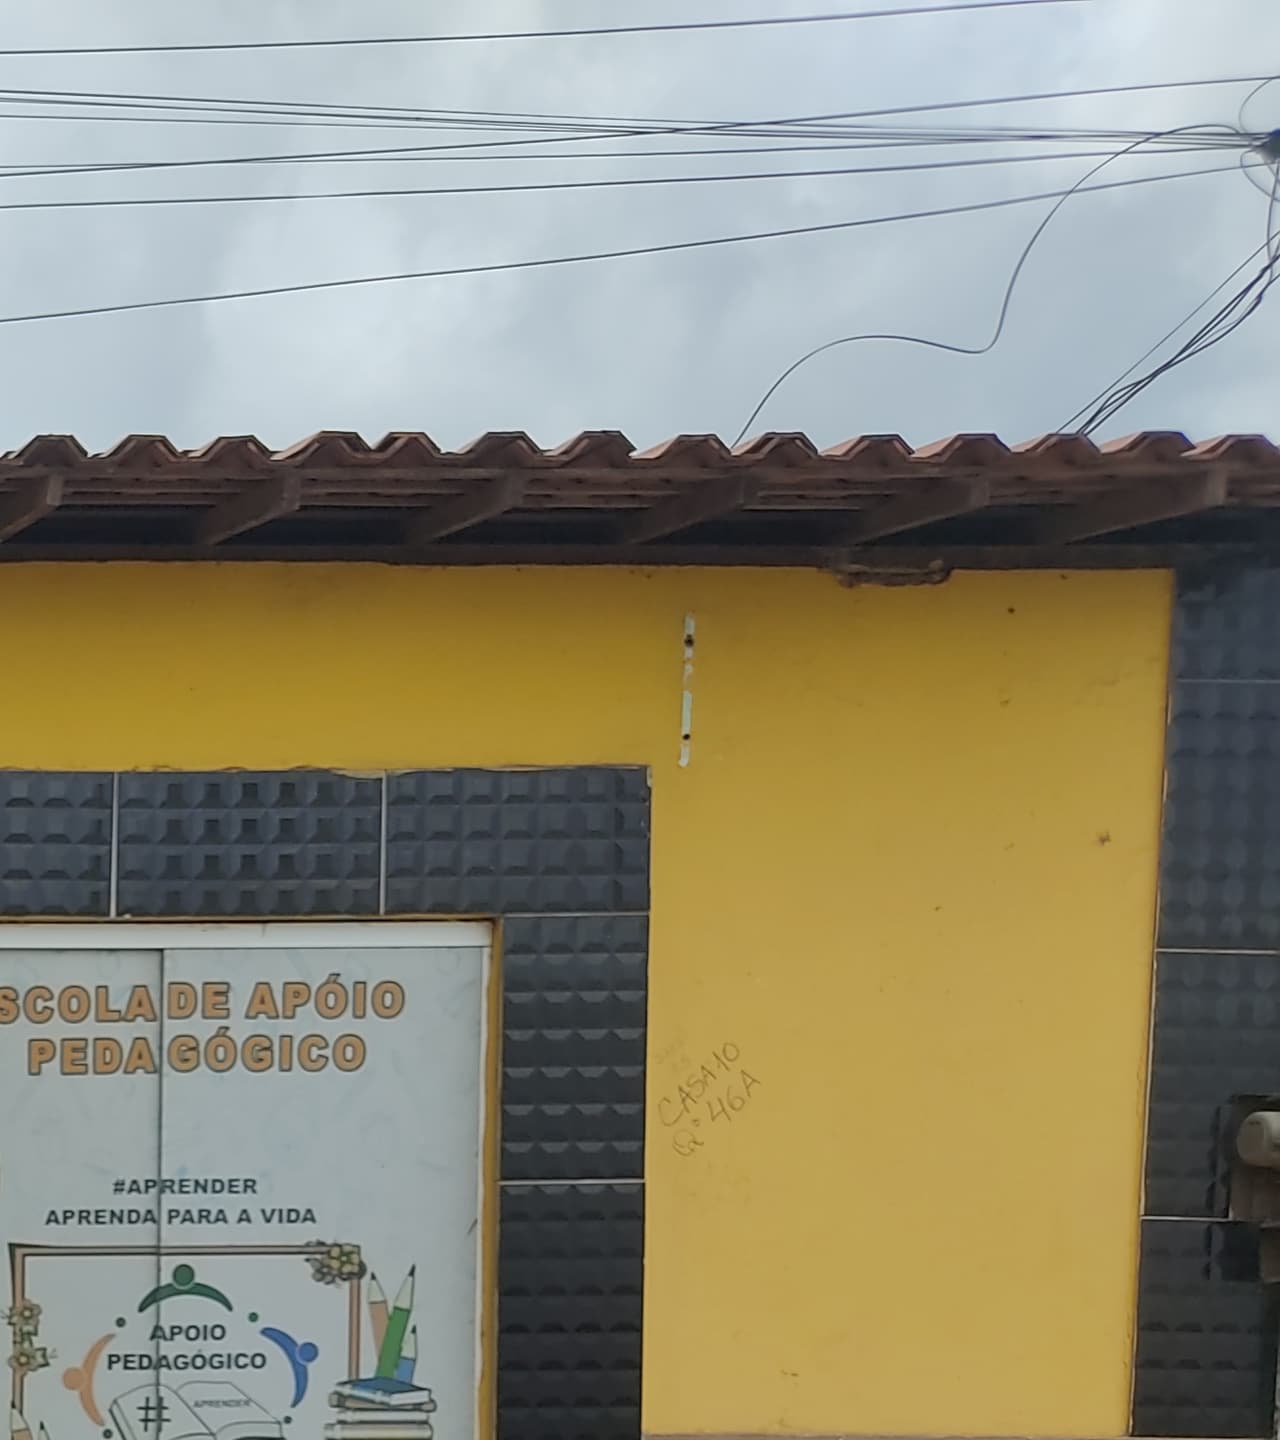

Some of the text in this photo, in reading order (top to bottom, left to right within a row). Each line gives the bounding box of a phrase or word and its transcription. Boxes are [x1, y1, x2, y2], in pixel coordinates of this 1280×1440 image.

[167, 981, 231, 1020] DE
[244, 973, 406, 1020] APÓIO
[28, 1026, 367, 1076] PEDAGÓGICO
[658, 1064, 718, 1127] CASA
[112, 1178, 258, 1195] #APRENDER
[44, 1208, 318, 1226] APRENDA PARA A VIDA
[149, 1324, 227, 1342] APOIO
[107, 1349, 268, 1371] PEDAGÓGICO
